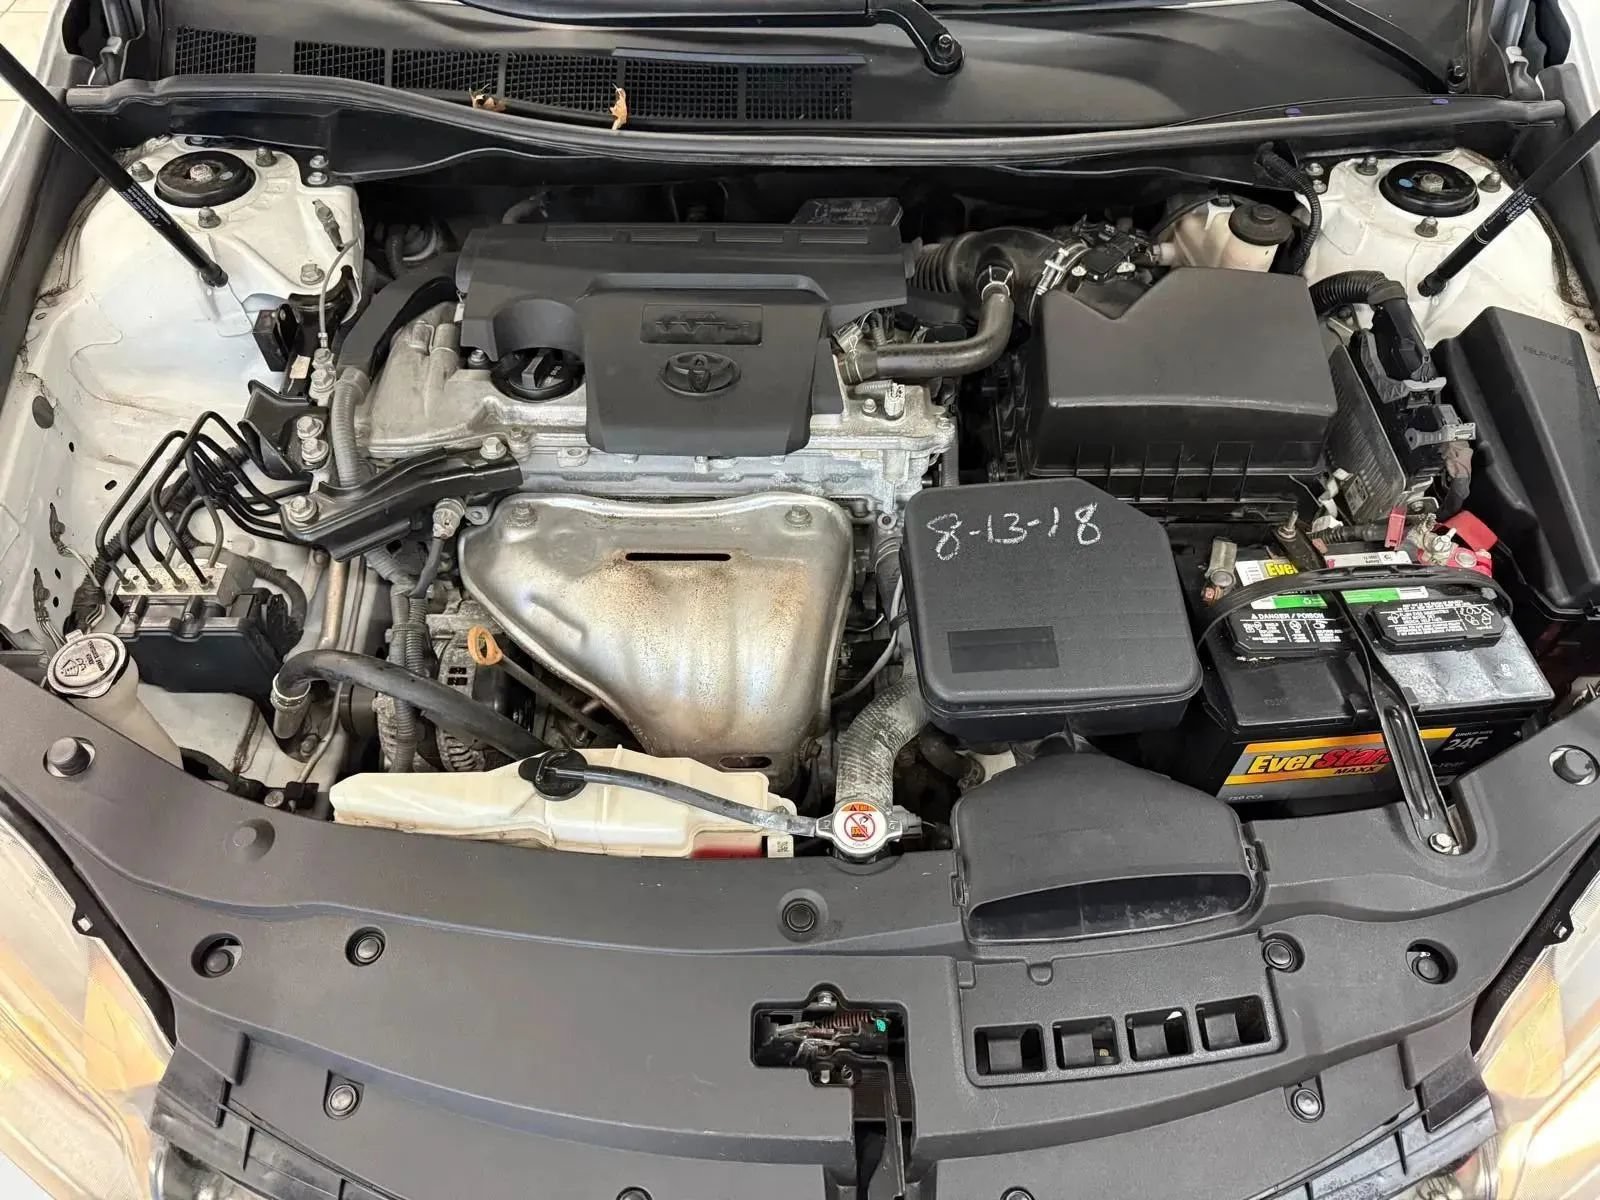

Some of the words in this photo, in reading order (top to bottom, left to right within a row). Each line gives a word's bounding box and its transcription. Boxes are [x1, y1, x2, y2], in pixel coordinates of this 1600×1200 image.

[926, 502, 1101, 560] 8-13-18
[1443, 736, 1489, 751] 24F
[1333, 765, 1377, 775] MAXX
